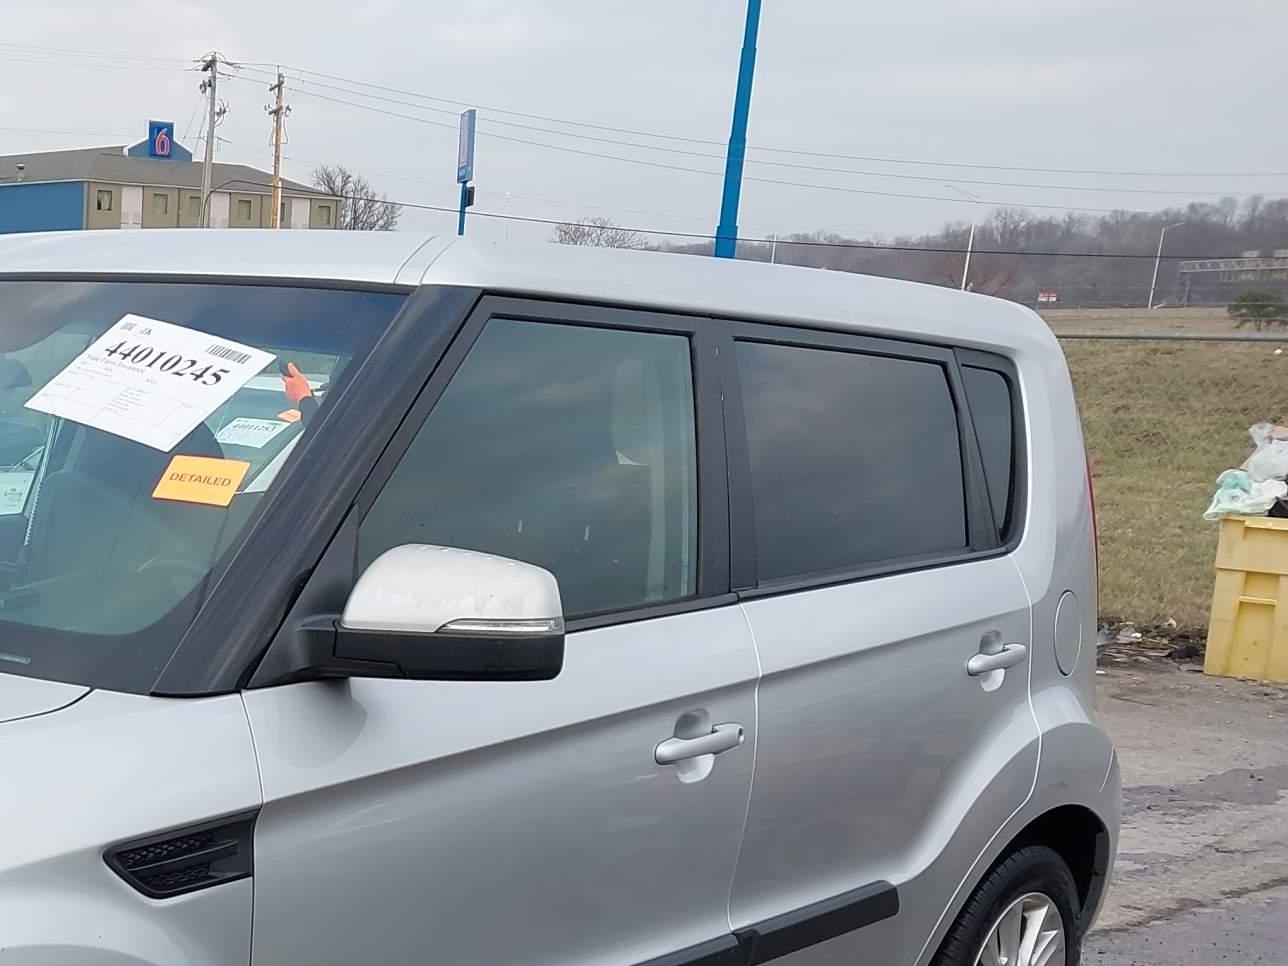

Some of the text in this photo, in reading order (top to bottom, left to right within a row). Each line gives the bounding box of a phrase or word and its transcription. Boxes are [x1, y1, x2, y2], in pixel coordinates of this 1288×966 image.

[155, 128, 170, 156] 6
[105, 340, 231, 386] 44010245
[169, 472, 232, 487] DETAILED
